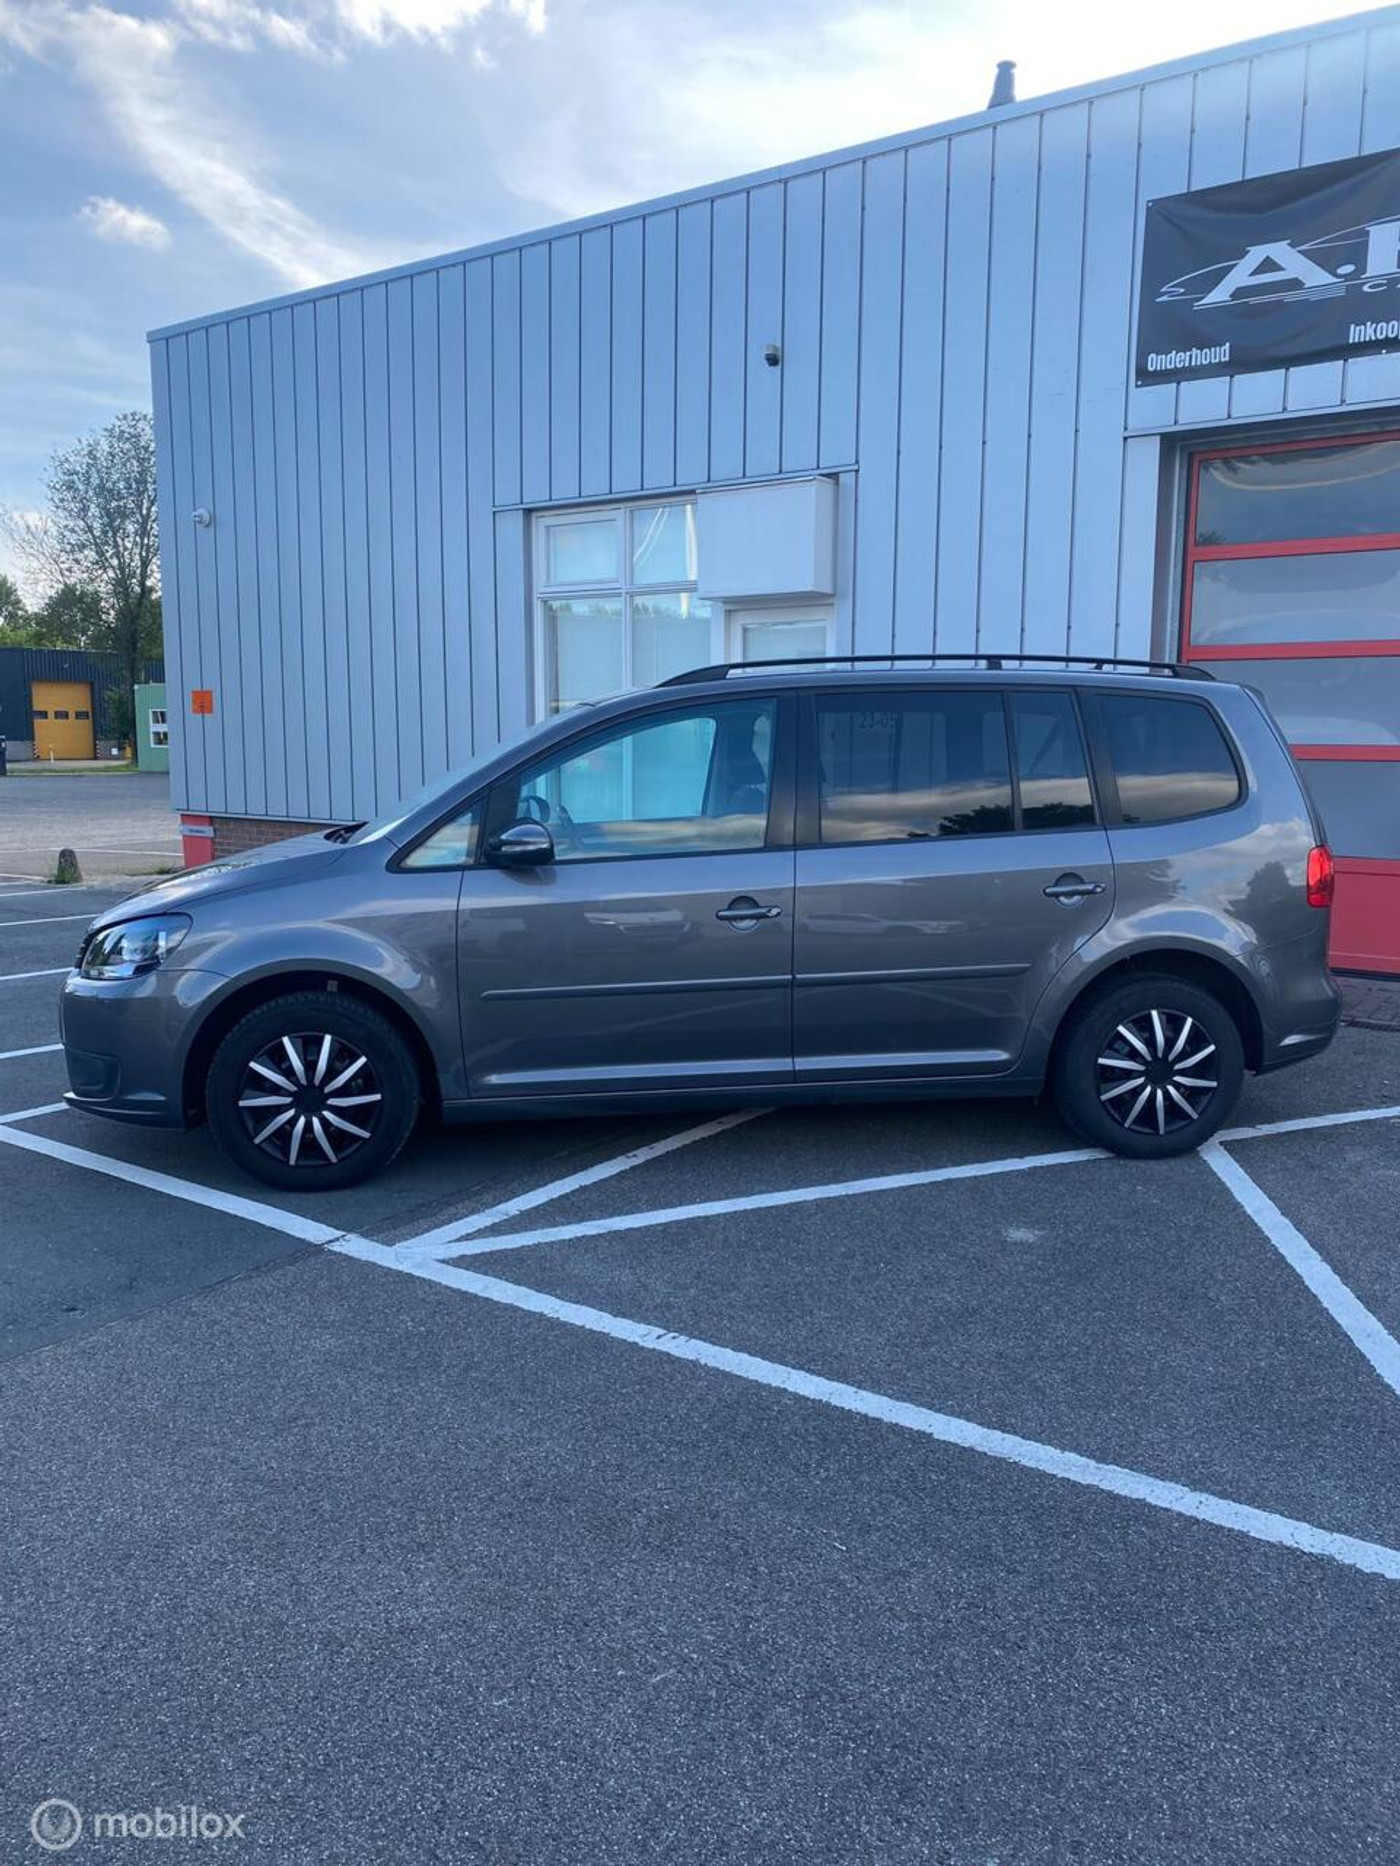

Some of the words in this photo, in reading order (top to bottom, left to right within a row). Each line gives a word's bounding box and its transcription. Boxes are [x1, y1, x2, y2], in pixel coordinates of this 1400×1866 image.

[1362, 280, 1400, 292] C
[1348, 320, 1400, 344] Inkoo
[1147, 342, 1230, 372] Onderhoud
